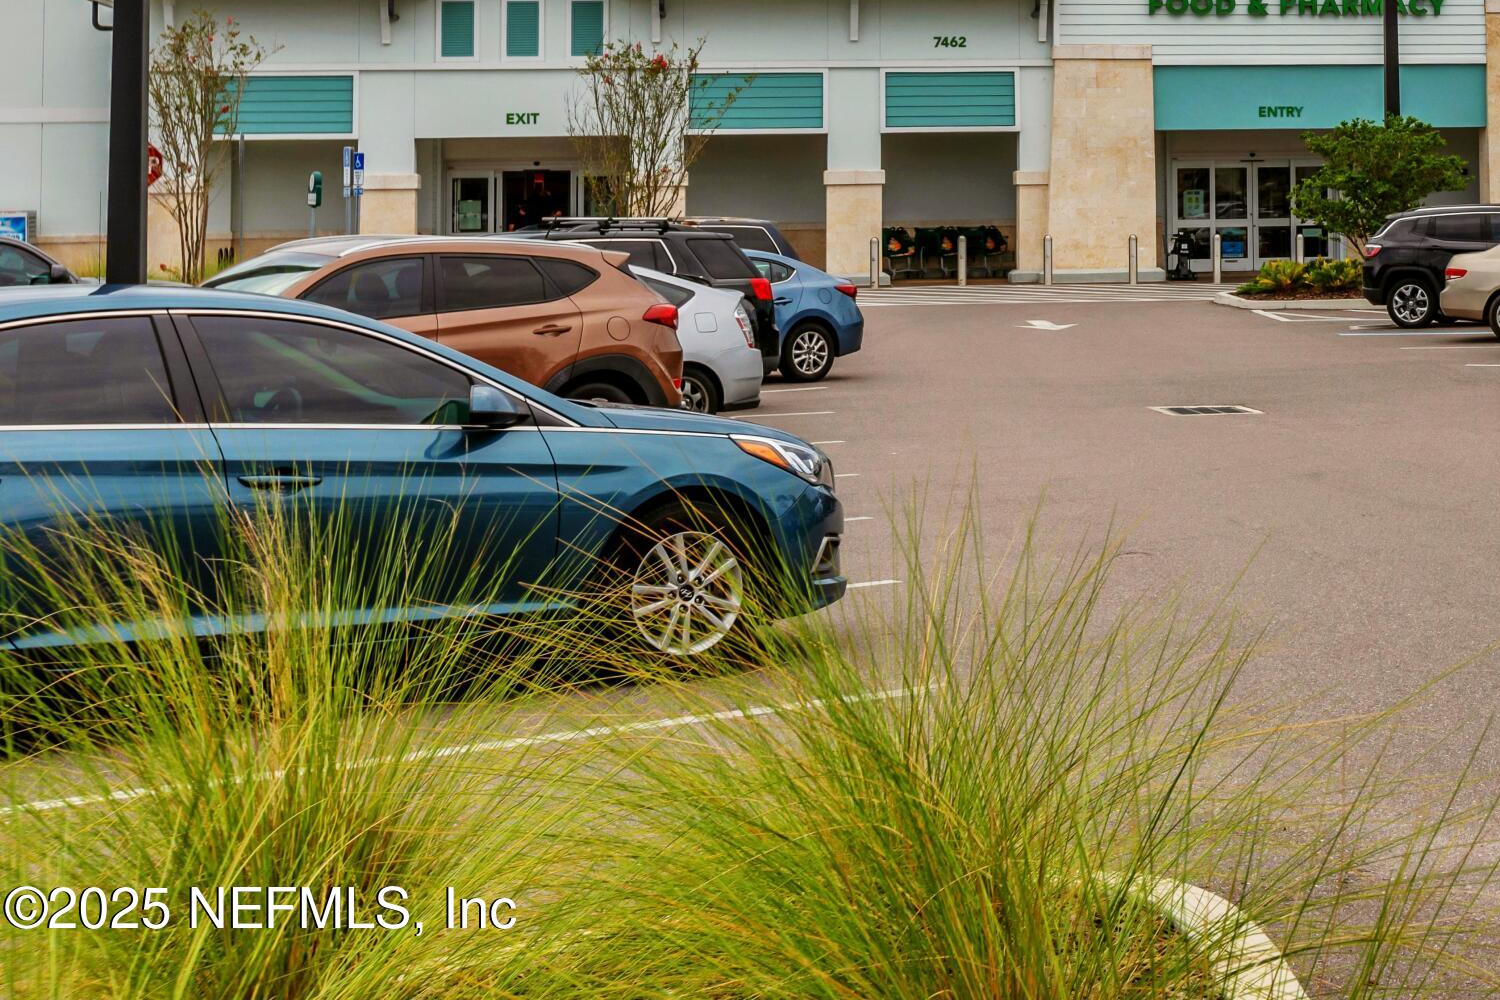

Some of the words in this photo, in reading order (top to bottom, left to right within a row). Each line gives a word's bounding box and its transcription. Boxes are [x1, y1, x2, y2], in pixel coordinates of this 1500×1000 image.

[933, 36, 967, 48] 7462
[1258, 106, 1304, 118] ENTRY
[506, 112, 540, 125] EXIT
